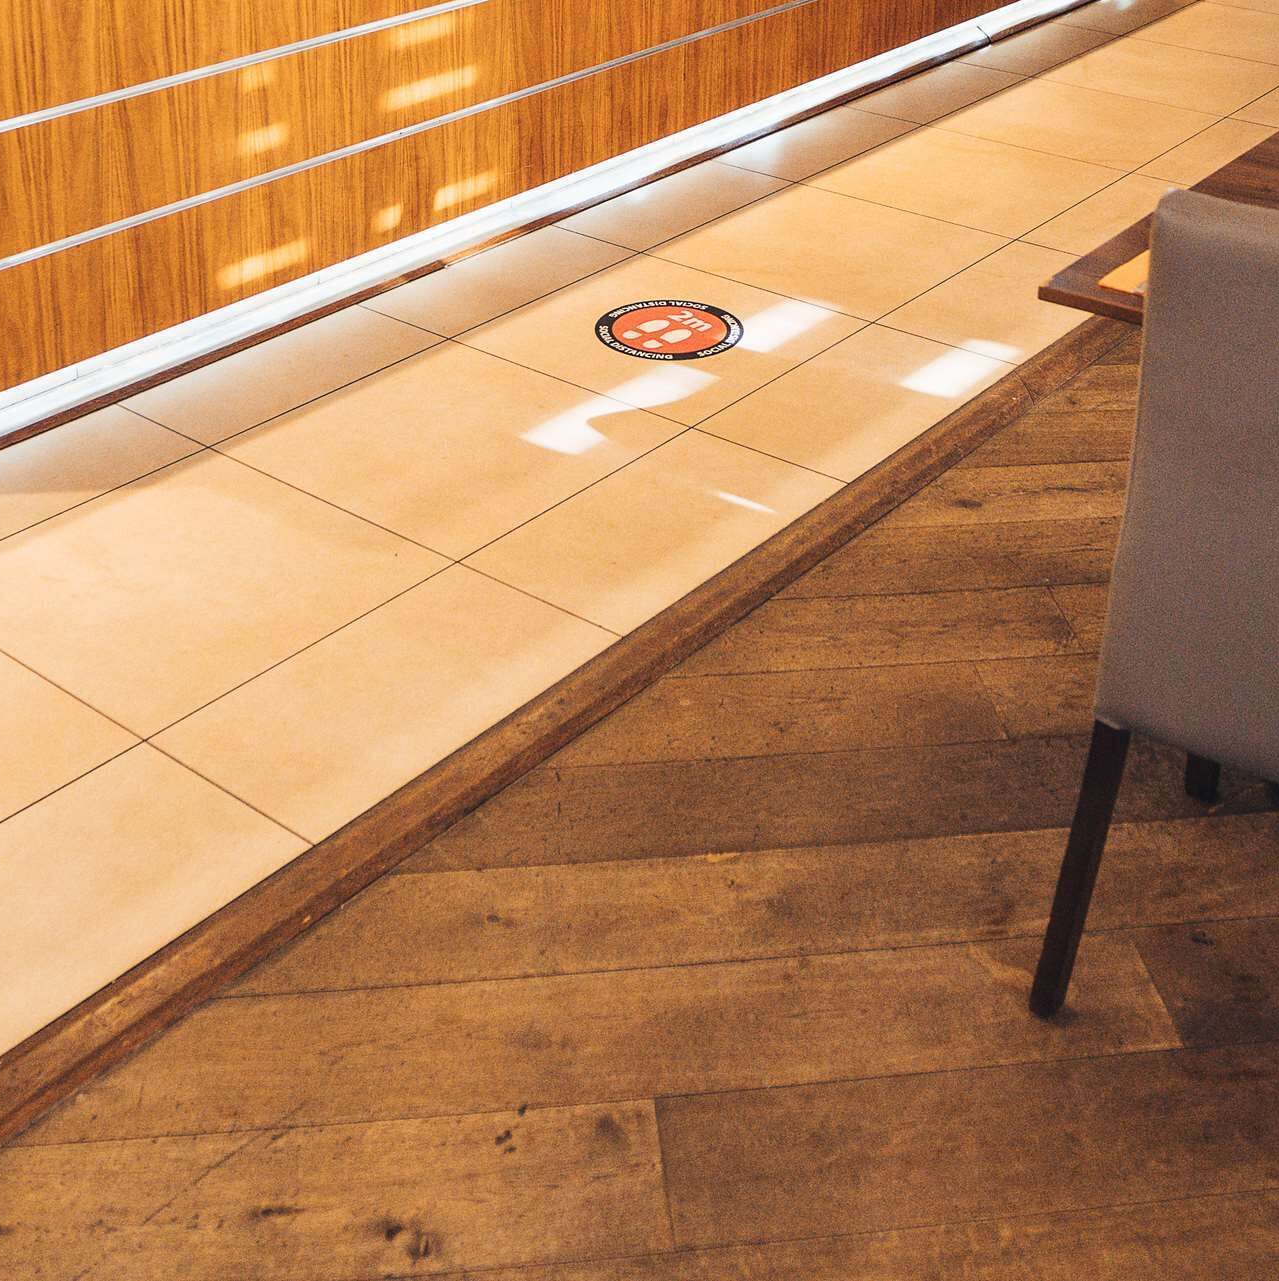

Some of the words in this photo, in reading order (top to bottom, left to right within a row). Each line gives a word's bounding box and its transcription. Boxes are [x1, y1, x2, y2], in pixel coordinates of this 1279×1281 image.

[608, 301, 667, 318] DISTANCING
[667, 310, 712, 332] 2m
[611, 341, 674, 360] DISTANCING
